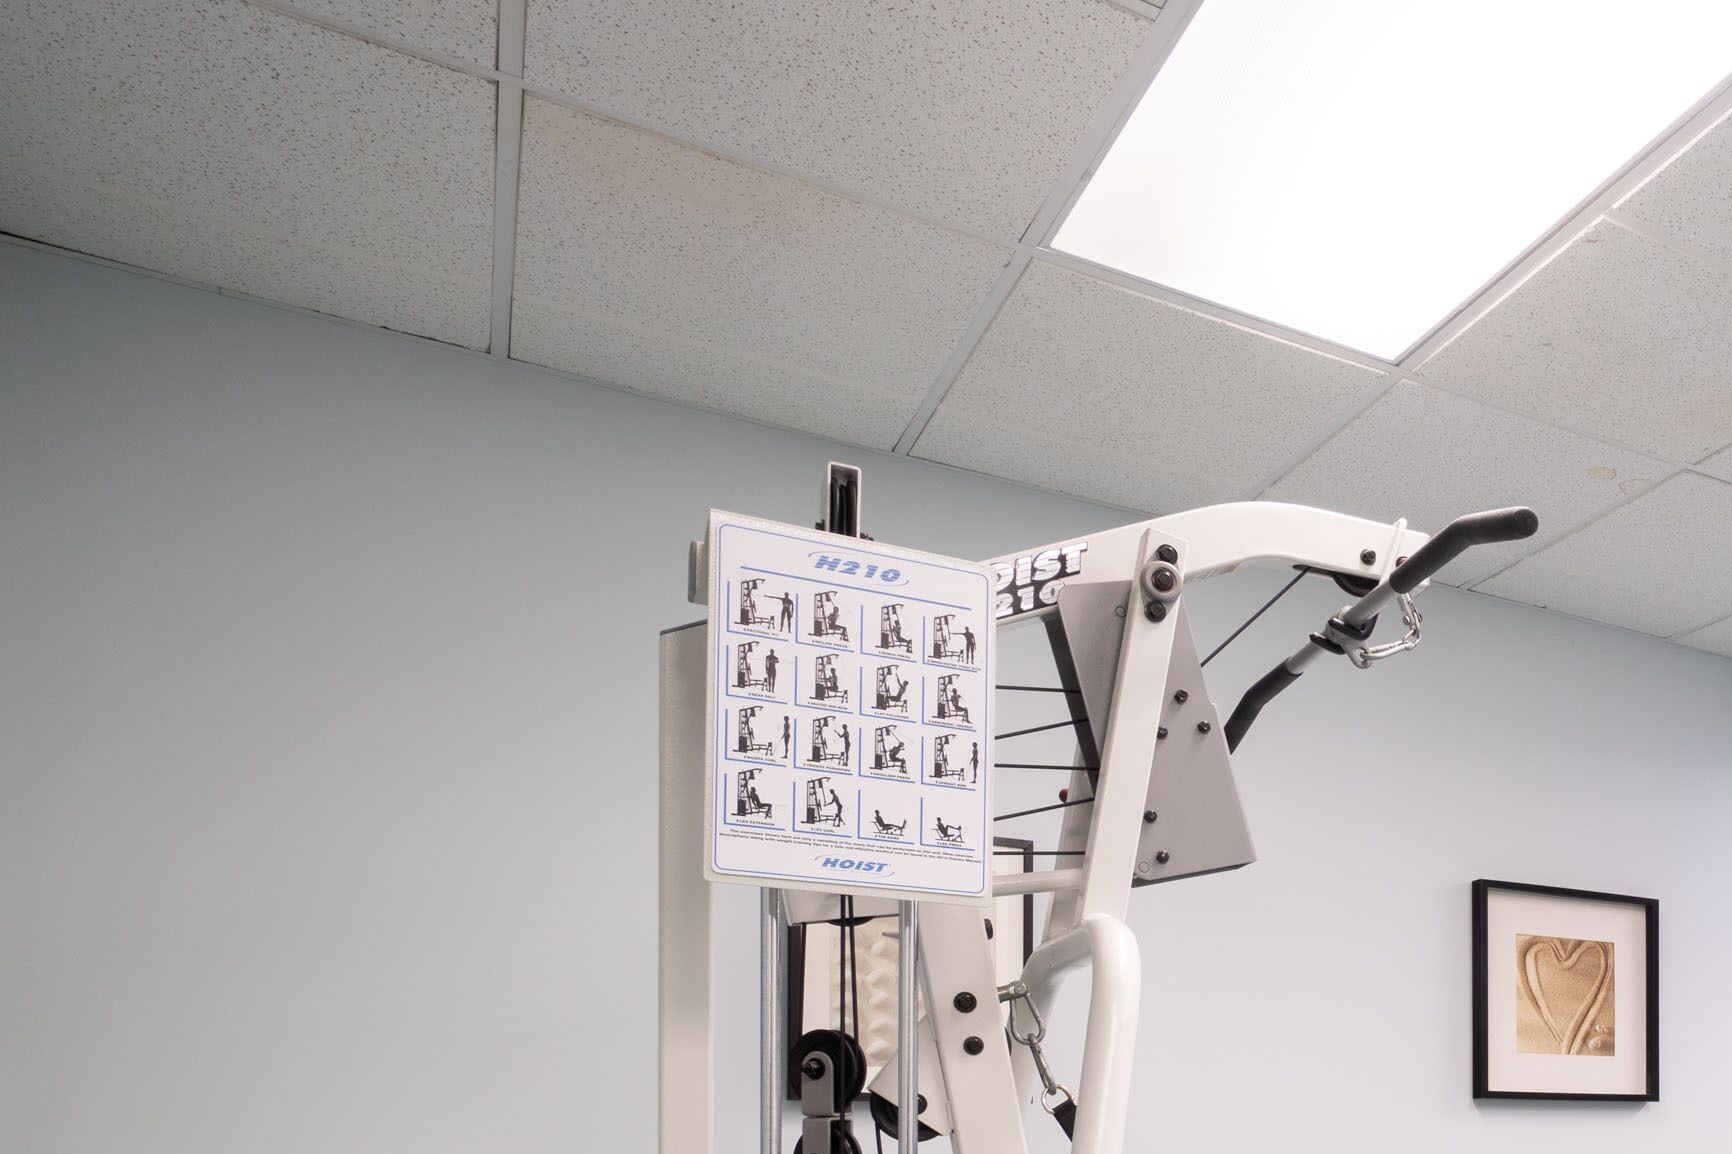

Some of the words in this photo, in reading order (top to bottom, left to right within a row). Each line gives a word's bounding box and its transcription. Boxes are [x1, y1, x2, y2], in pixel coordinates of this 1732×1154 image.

[814, 555, 901, 582] H210
[990, 542, 1088, 592] OIST
[996, 579, 1065, 618] 210
[822, 857, 888, 872] HOIST
